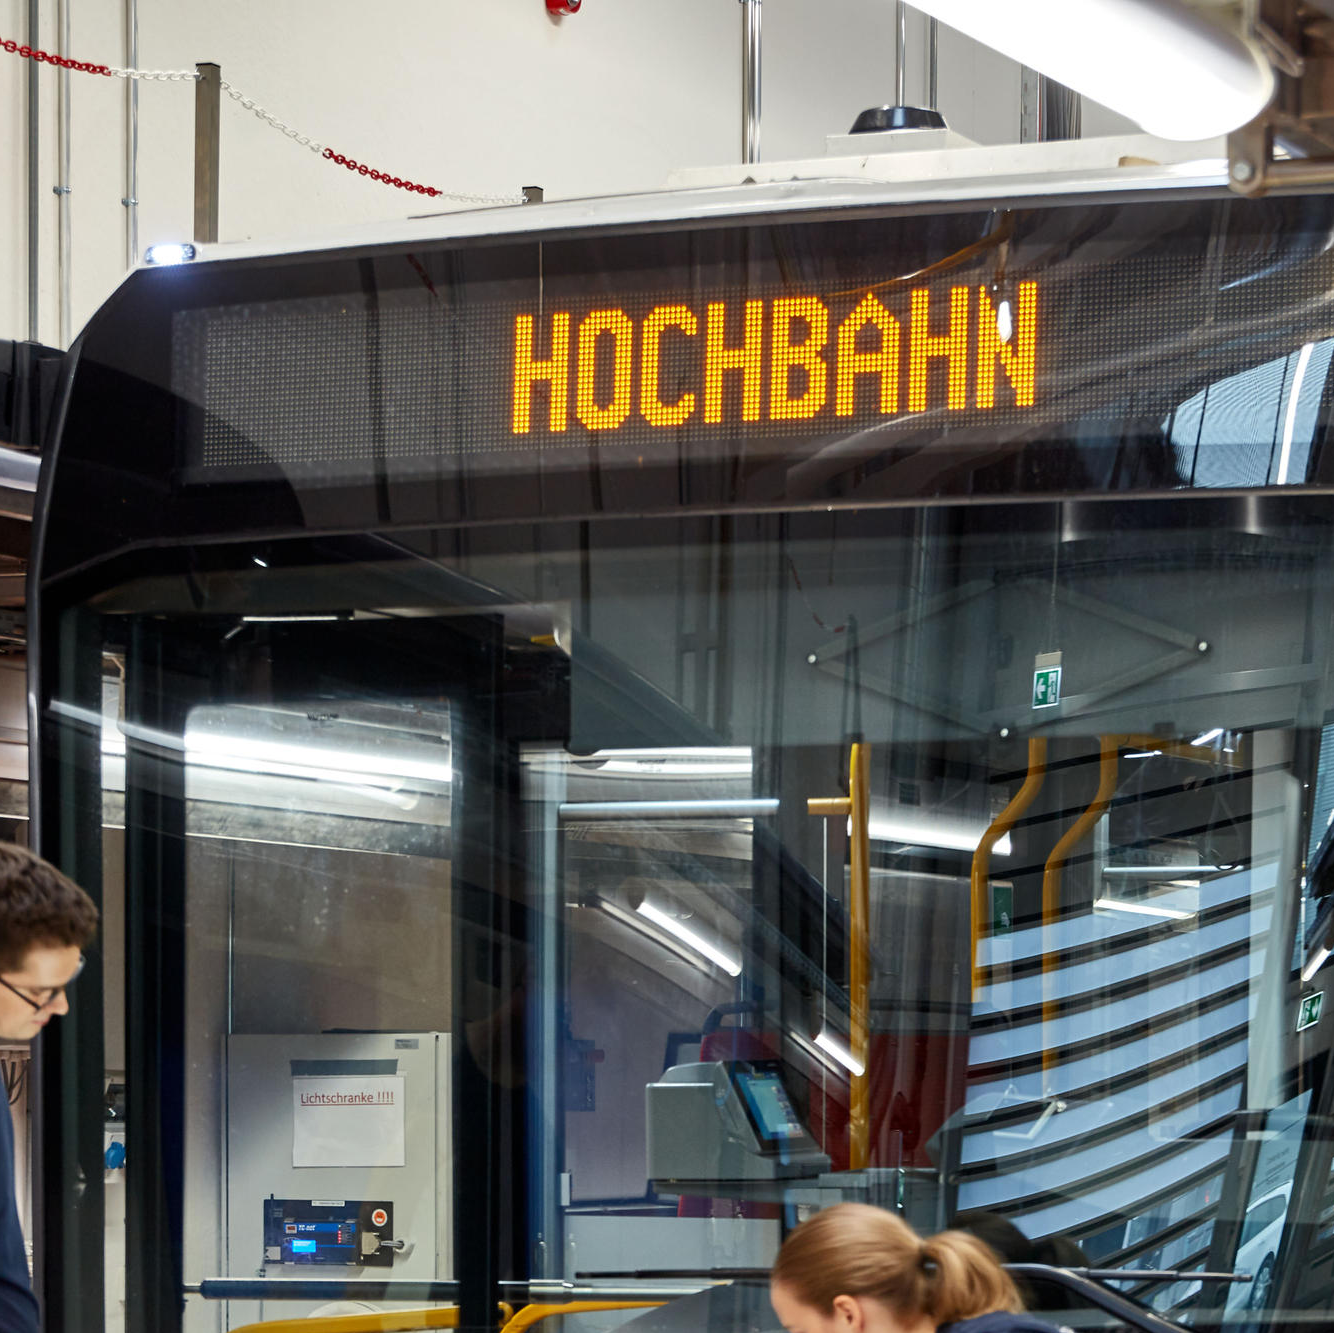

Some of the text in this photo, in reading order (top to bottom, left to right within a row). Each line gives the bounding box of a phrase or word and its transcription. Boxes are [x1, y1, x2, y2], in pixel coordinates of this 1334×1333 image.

[513, 281, 1037, 433] HOCHBAHN
[300, 1091, 395, 1105] Lichtschranke !!!!
